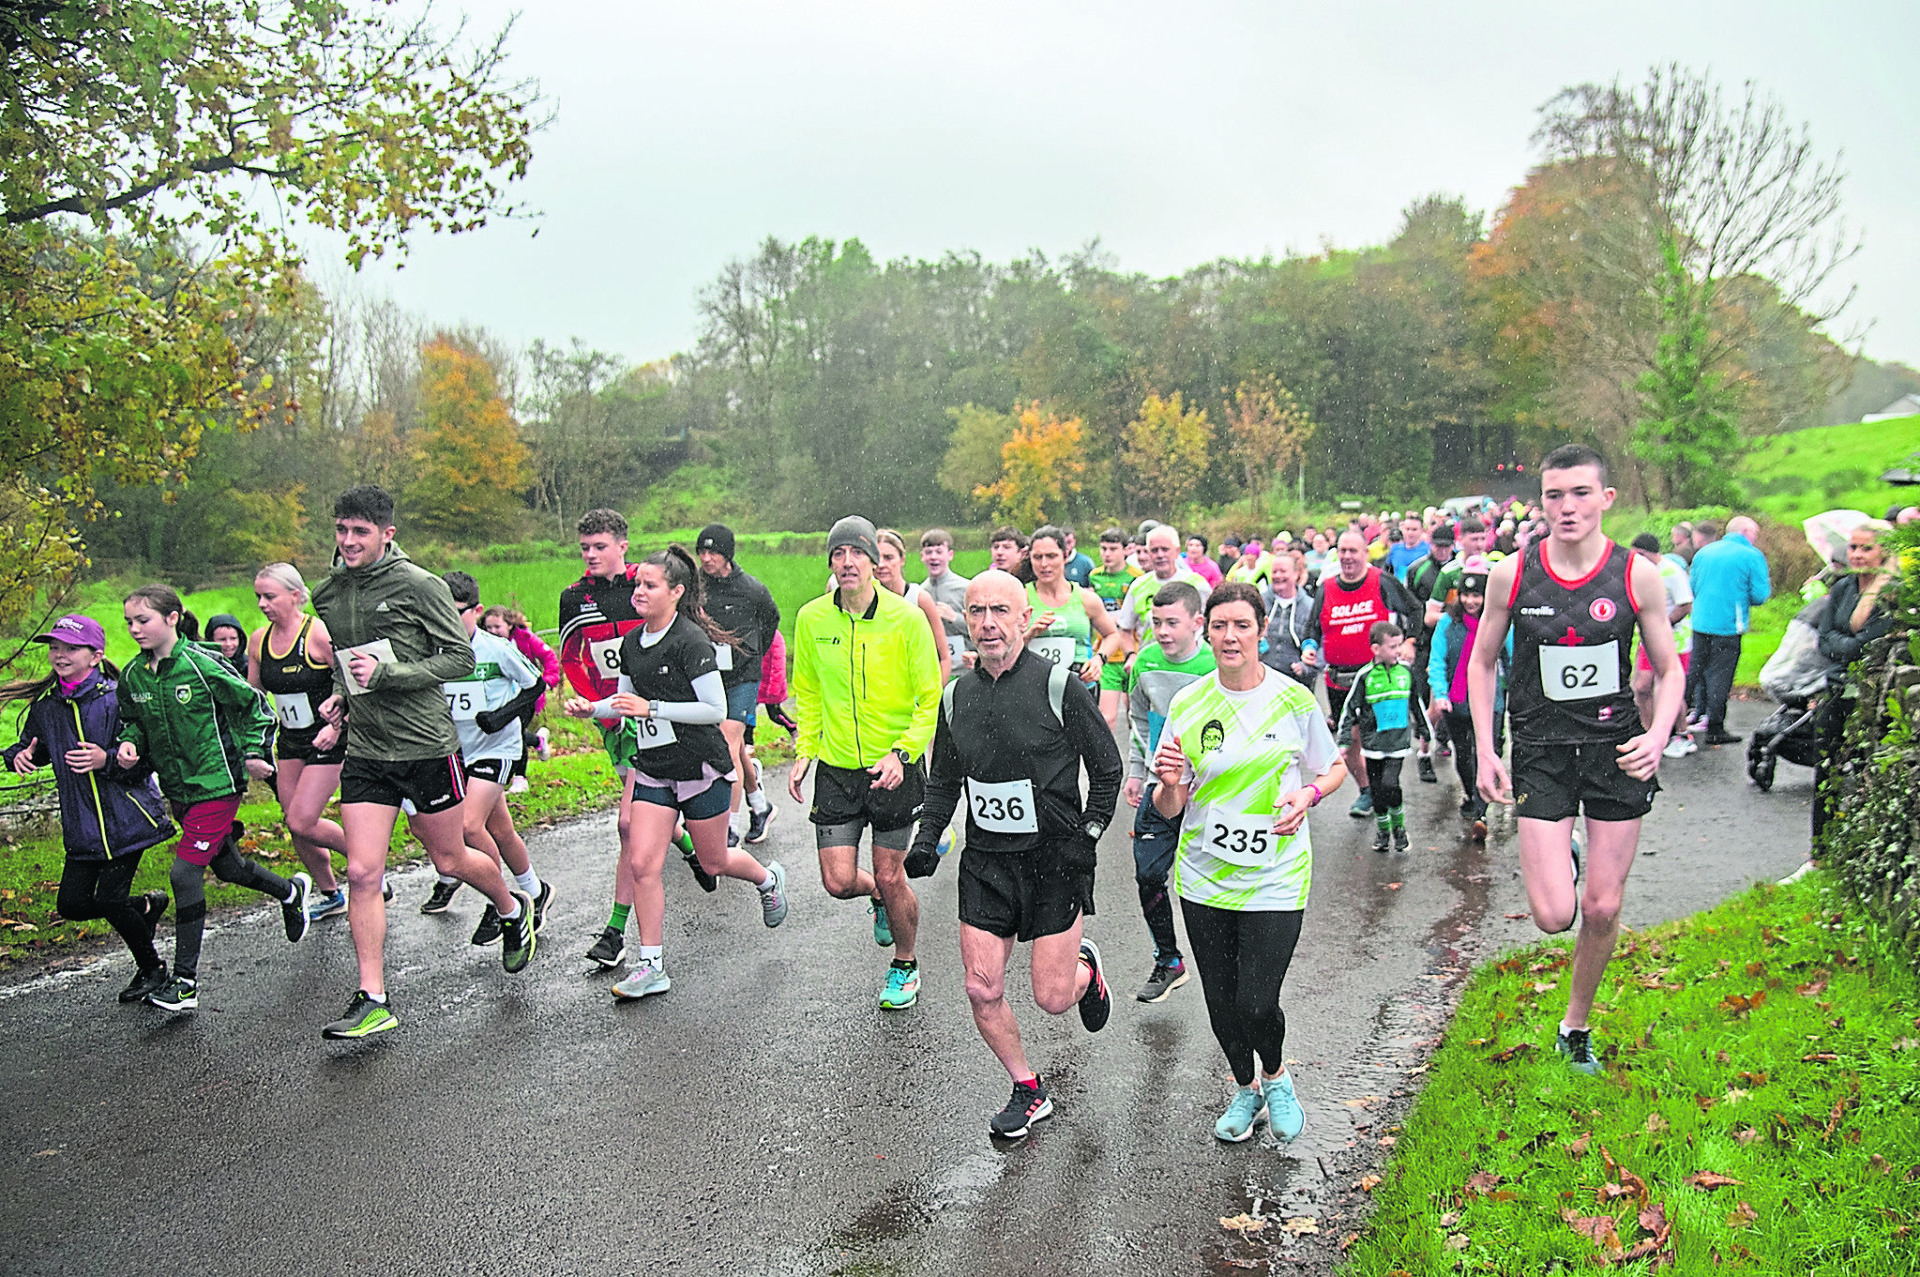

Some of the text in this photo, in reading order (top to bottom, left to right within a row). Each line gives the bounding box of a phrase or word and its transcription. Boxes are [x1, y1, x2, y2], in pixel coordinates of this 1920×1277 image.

[1330, 599, 1374, 618] SOLACE
[1041, 648, 1061, 665] 28
[1561, 664, 1599, 689] 62
[445, 693, 471, 711] 75
[281, 705, 298, 721] 11
[975, 795, 1025, 821] 236
[1212, 823, 1268, 854] 235
